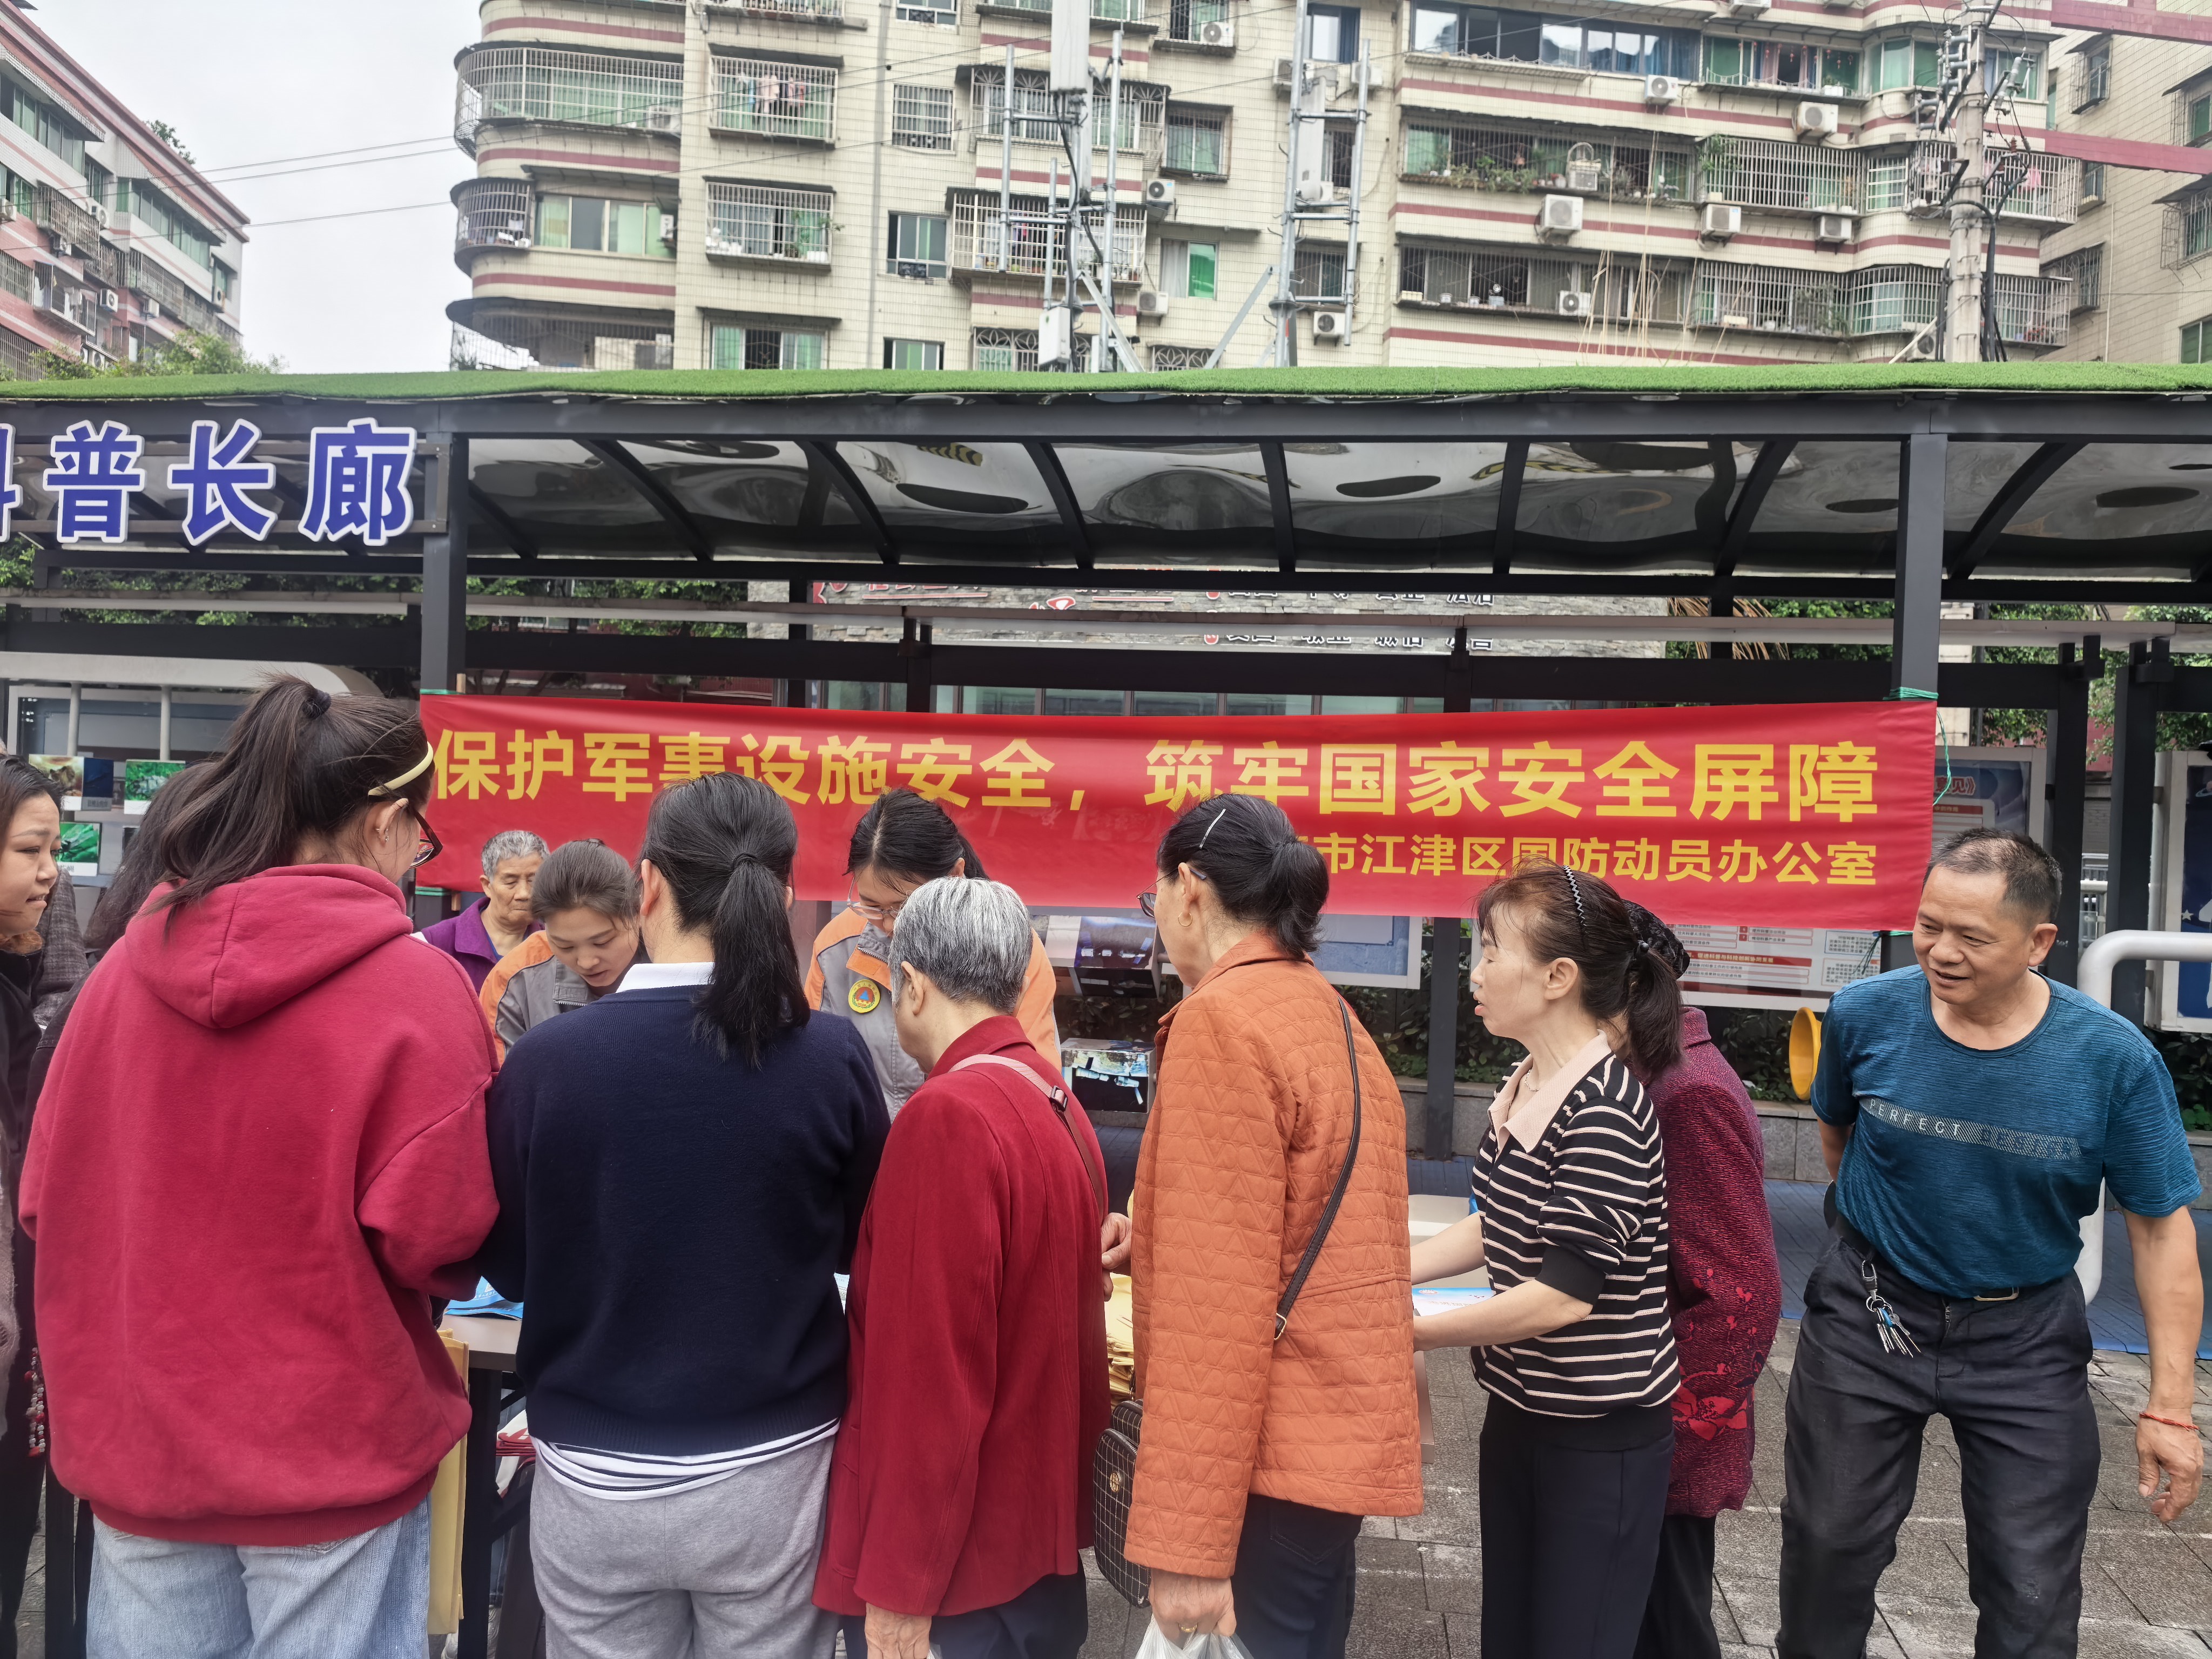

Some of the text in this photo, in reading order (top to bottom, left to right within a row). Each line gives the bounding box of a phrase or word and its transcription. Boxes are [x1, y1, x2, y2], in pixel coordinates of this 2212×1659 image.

[0, 417, 417, 546] 普长廊
[1296, 832, 1877, 885] 市江津区国防动员办公室
[1870, 1098, 1960, 1136] PERFECT
